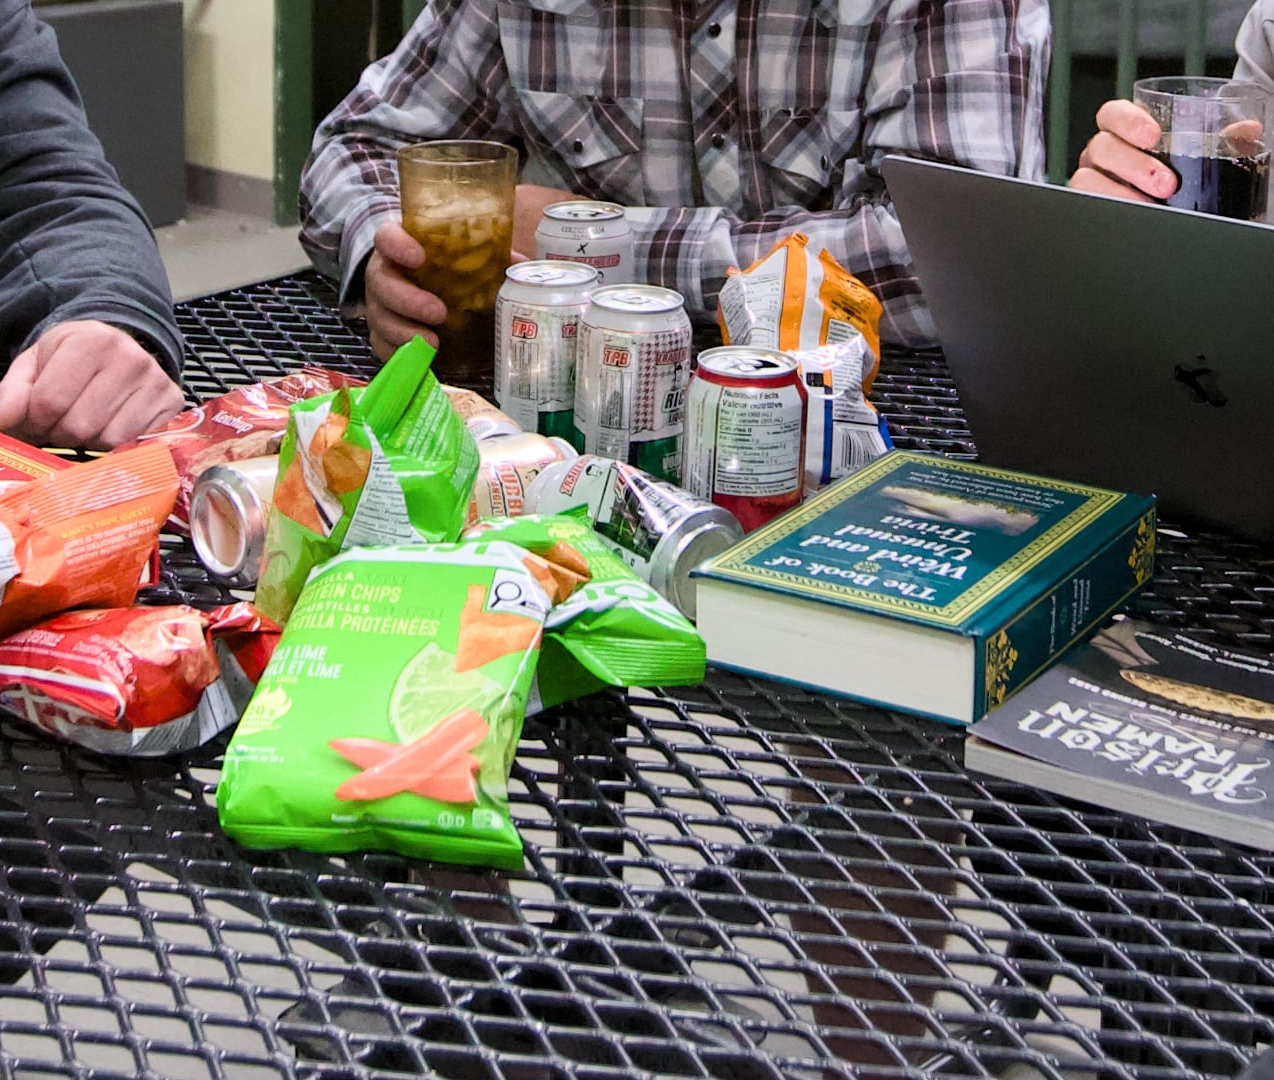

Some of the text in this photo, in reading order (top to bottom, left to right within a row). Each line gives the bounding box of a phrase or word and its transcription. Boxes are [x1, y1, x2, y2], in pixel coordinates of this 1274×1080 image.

[513, 319, 537, 339] TPB
[604, 347, 629, 367] TPB
[760, 392, 779, 400] Facts
[872, 514, 981, 543] Trivia
[832, 523, 977, 561] Unusual
[797, 533, 974, 579] Weird and
[762, 553, 943, 601] The Book of
[351, 583, 402, 603] CHIPS
[292, 644, 329, 661] LIME
[287, 660, 343, 679] ET LIME
[1044, 700, 1236, 765] RAMEN
[1013, 709, 1270, 803] Prison
